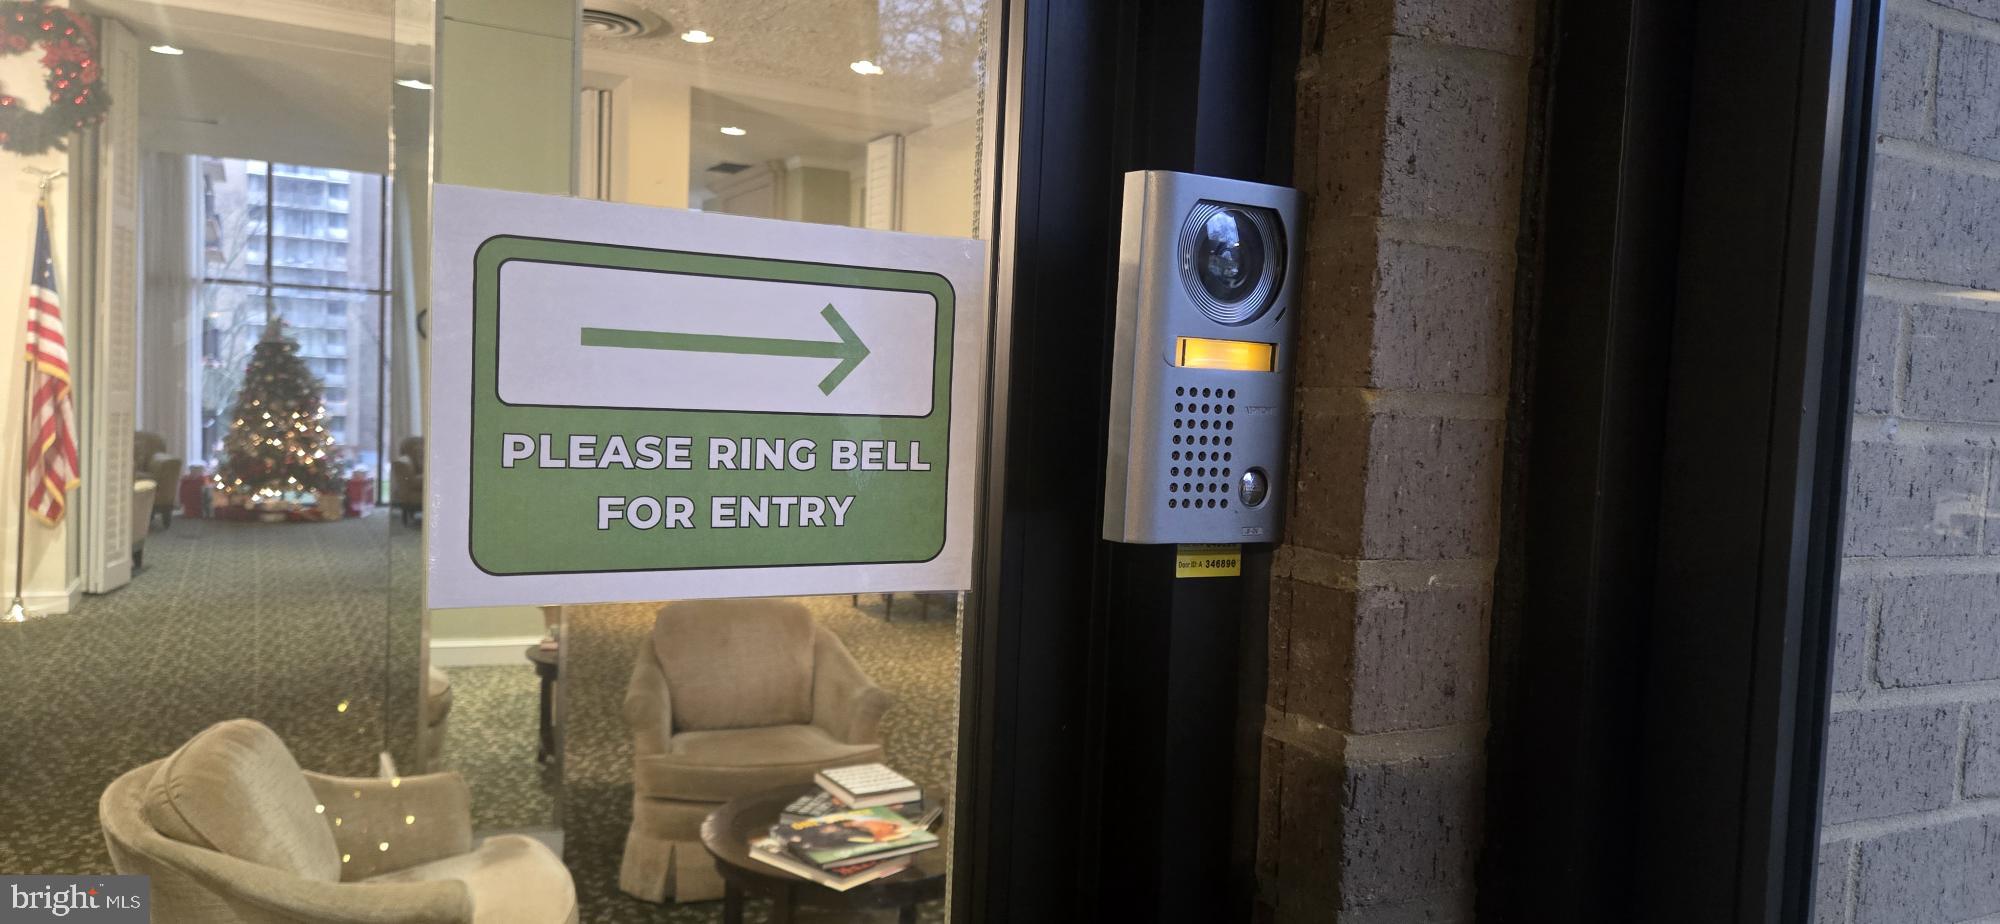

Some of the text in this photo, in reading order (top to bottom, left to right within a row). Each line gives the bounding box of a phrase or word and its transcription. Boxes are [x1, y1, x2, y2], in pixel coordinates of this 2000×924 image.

[502, 433, 931, 471] PLEASE RING BELL
[597, 495, 856, 530] FOR ENTRY
